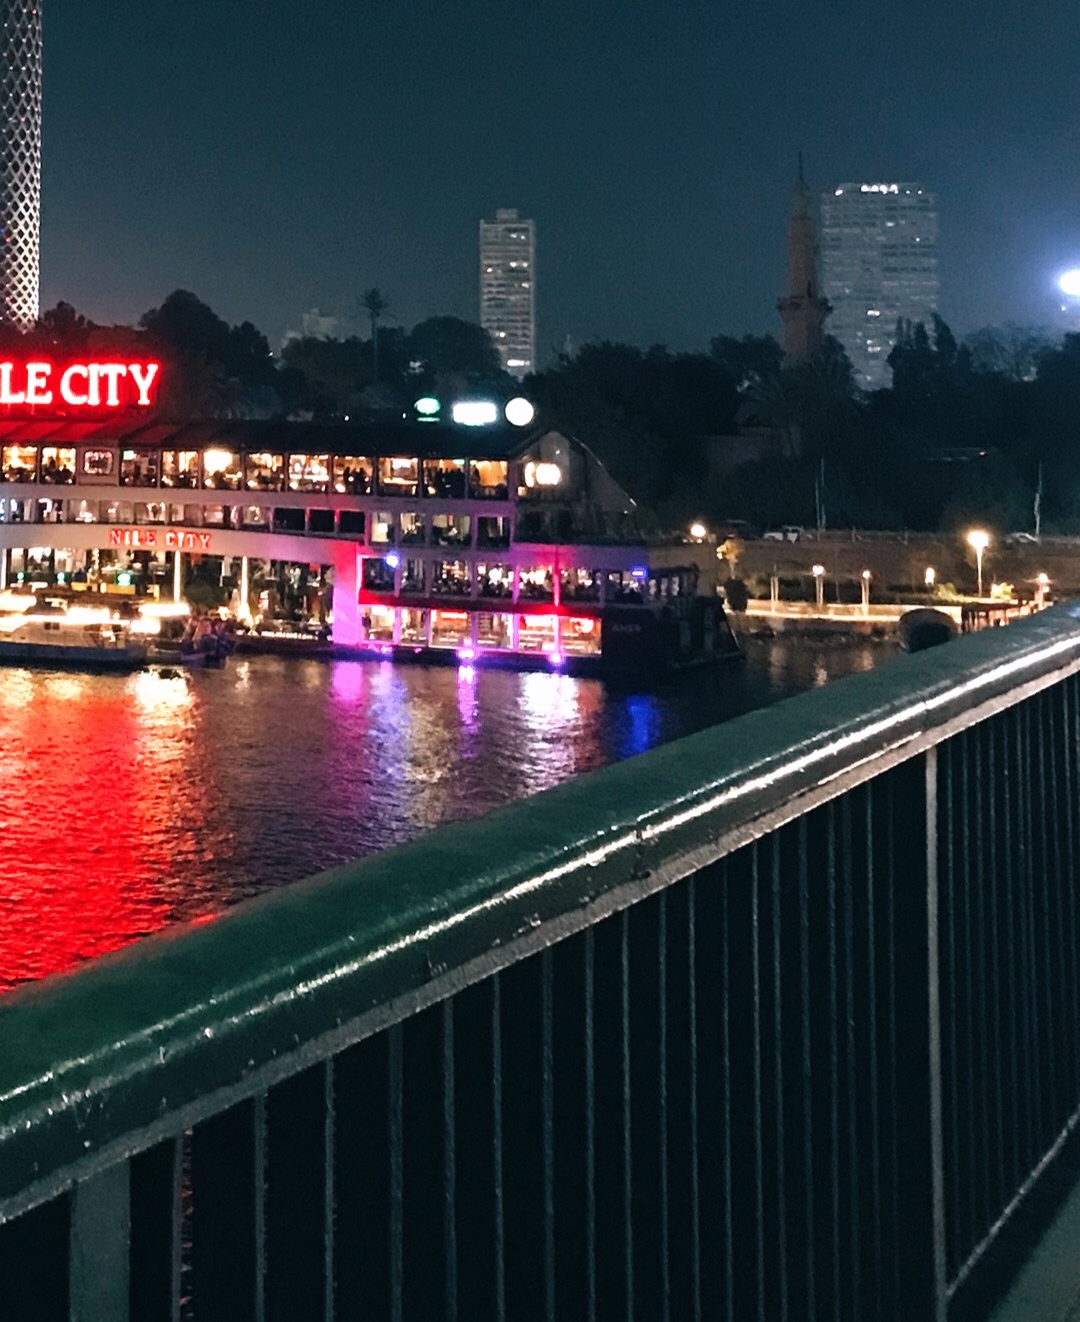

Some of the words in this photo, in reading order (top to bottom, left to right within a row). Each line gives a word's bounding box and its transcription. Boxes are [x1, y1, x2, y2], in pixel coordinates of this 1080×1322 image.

[61, 363, 159, 406] CITY
[110, 528, 156, 546] NILE
[165, 531, 211, 549] CITY
